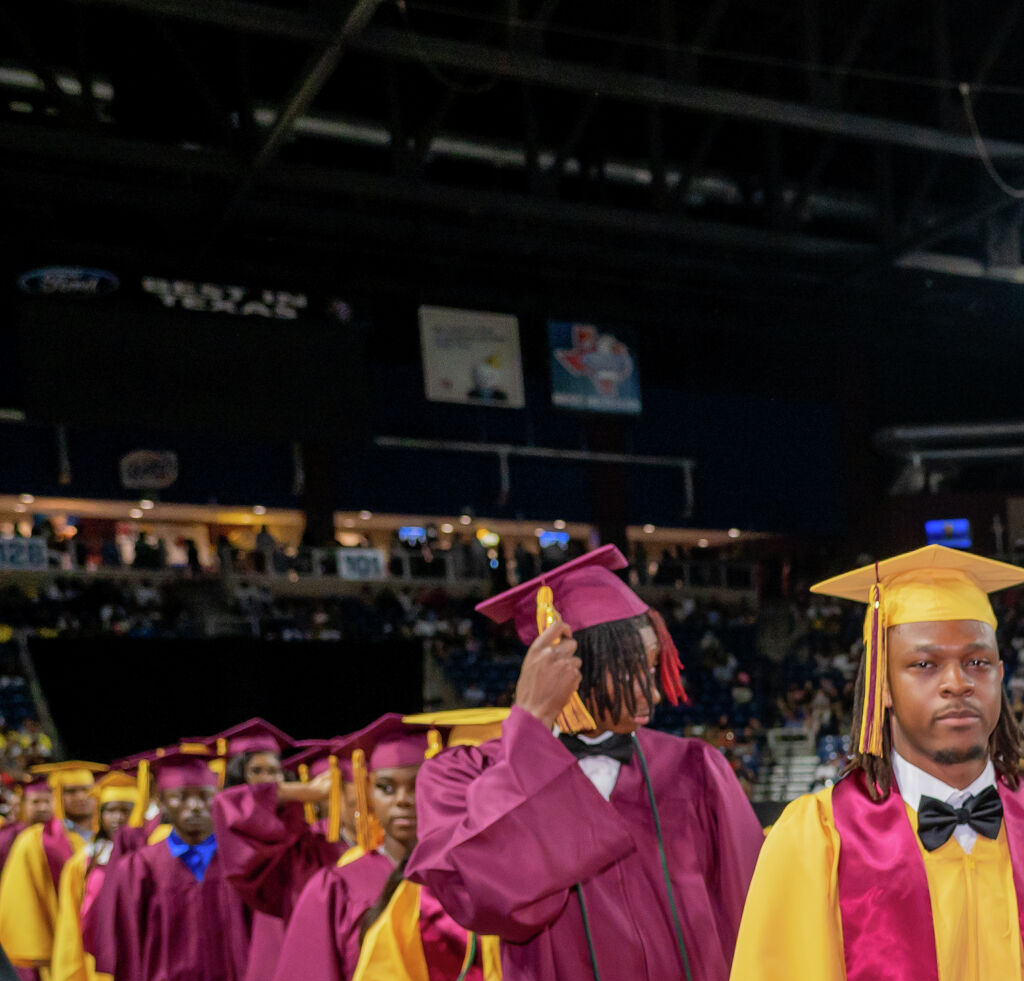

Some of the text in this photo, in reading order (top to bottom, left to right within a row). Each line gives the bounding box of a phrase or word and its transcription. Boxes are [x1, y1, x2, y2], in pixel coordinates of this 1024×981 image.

[141, 276, 308, 310] BEST IN
[160, 293, 299, 320] TEXAS
